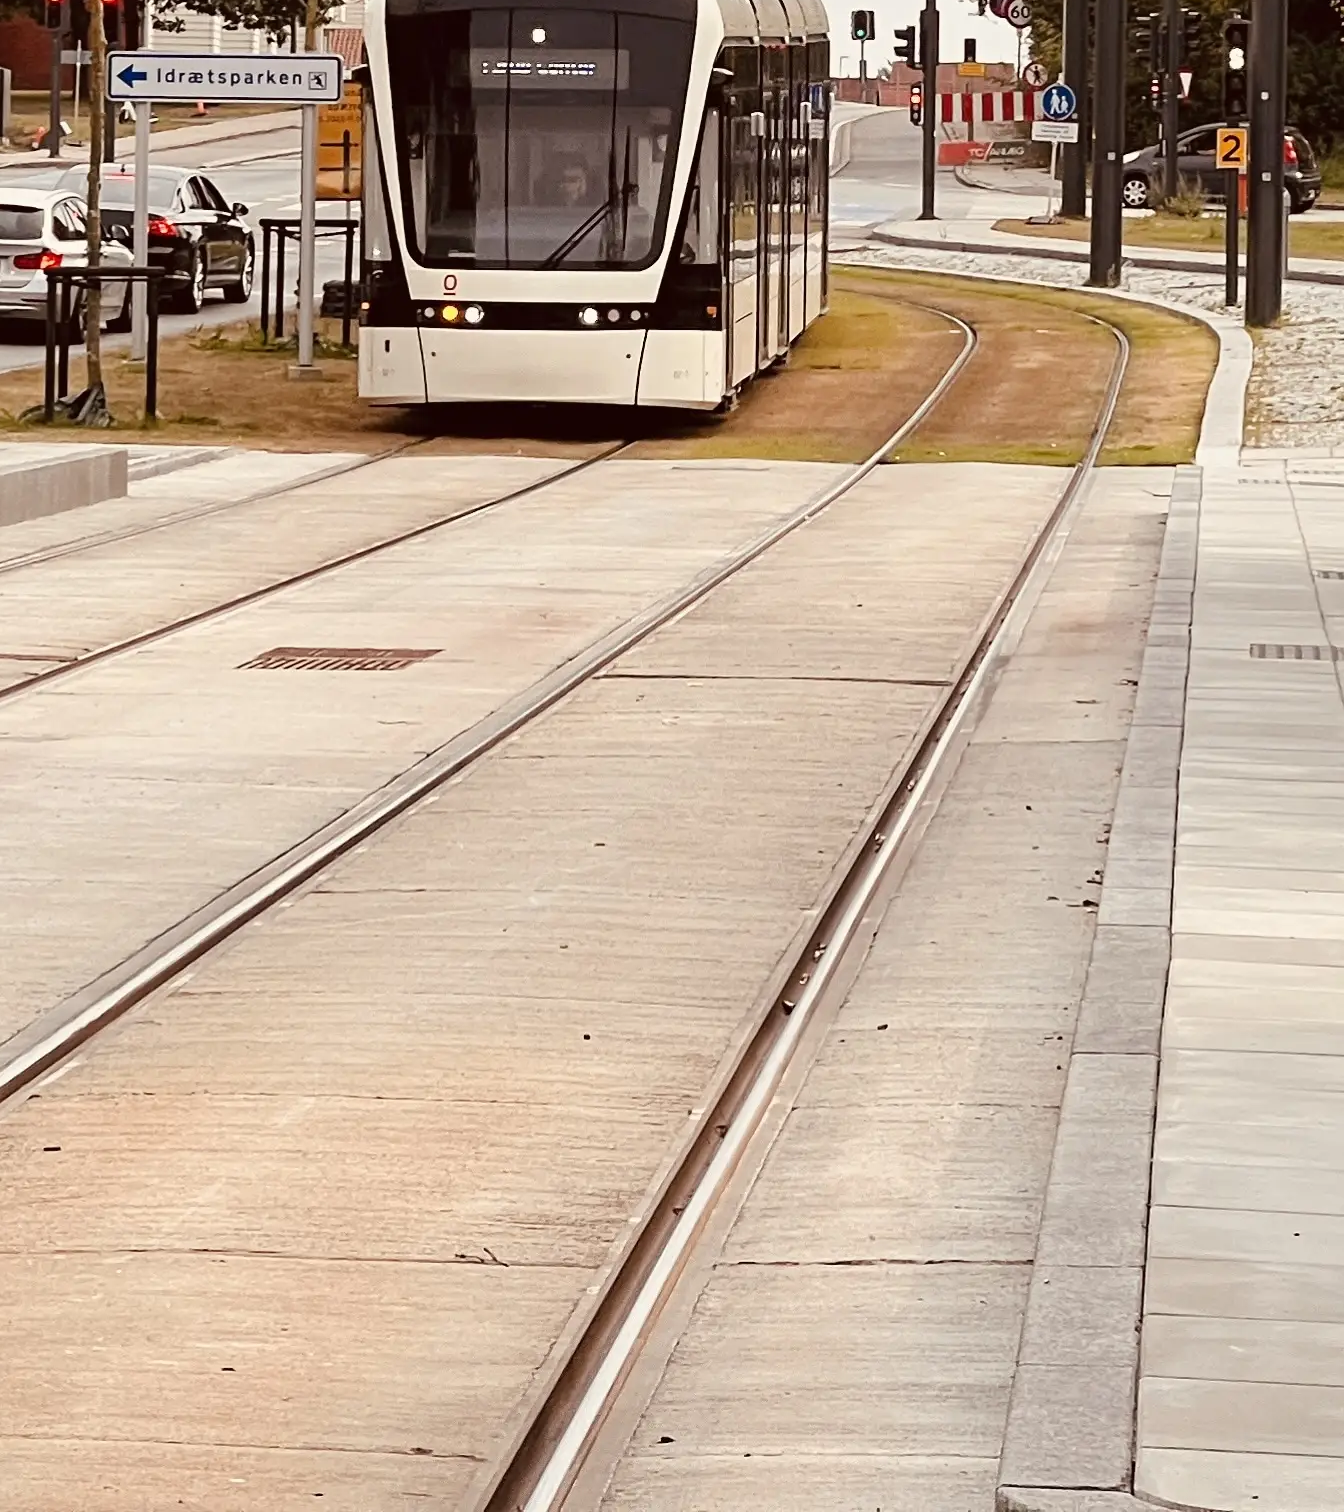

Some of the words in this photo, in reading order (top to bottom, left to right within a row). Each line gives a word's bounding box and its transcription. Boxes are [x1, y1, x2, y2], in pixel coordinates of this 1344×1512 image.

[1011, 5, 1031, 19] 60
[157, 68, 303, 87] Idrætsparken
[1222, 134, 1241, 162] 2
